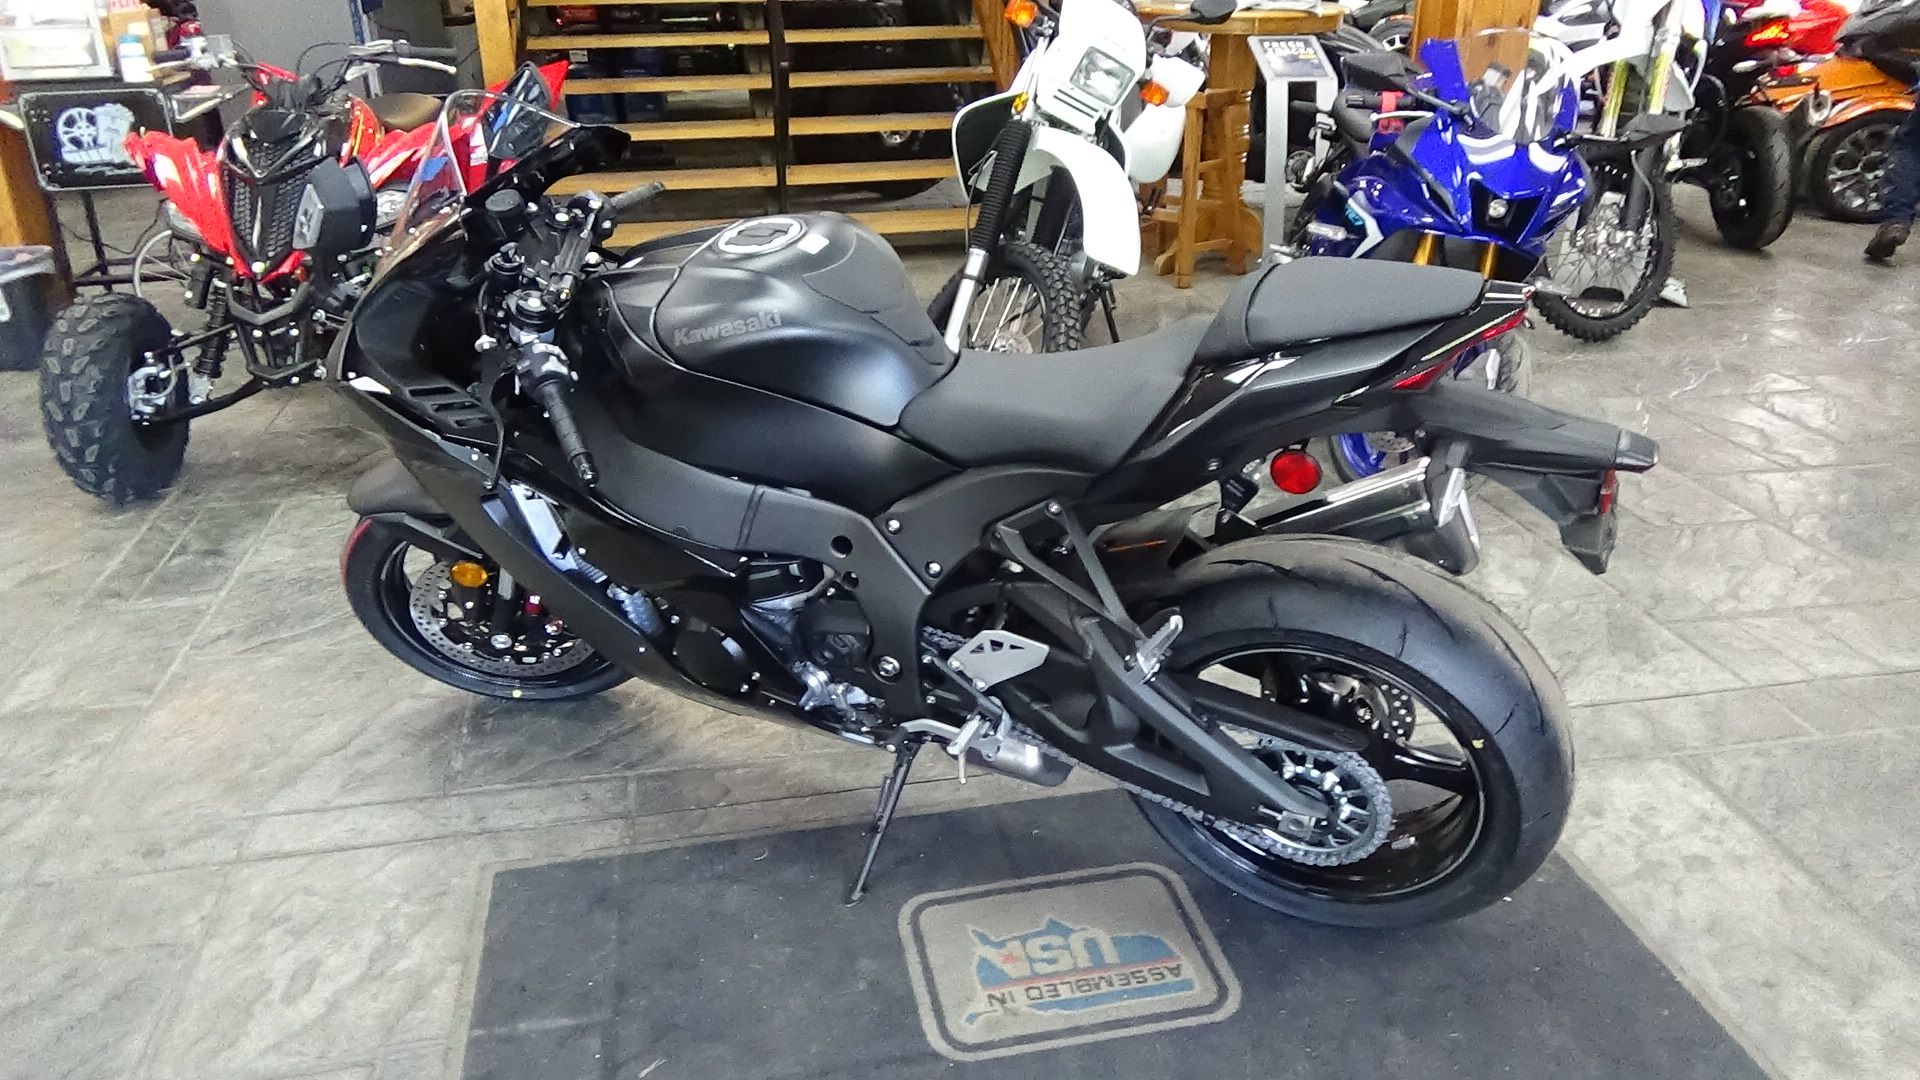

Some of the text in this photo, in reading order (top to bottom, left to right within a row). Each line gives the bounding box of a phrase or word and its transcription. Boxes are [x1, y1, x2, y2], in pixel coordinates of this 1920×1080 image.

[674, 310, 782, 346] Kawasaki
[974, 929, 1120, 978] USA
[987, 963, 1182, 1006] ASSEMBLED IN
